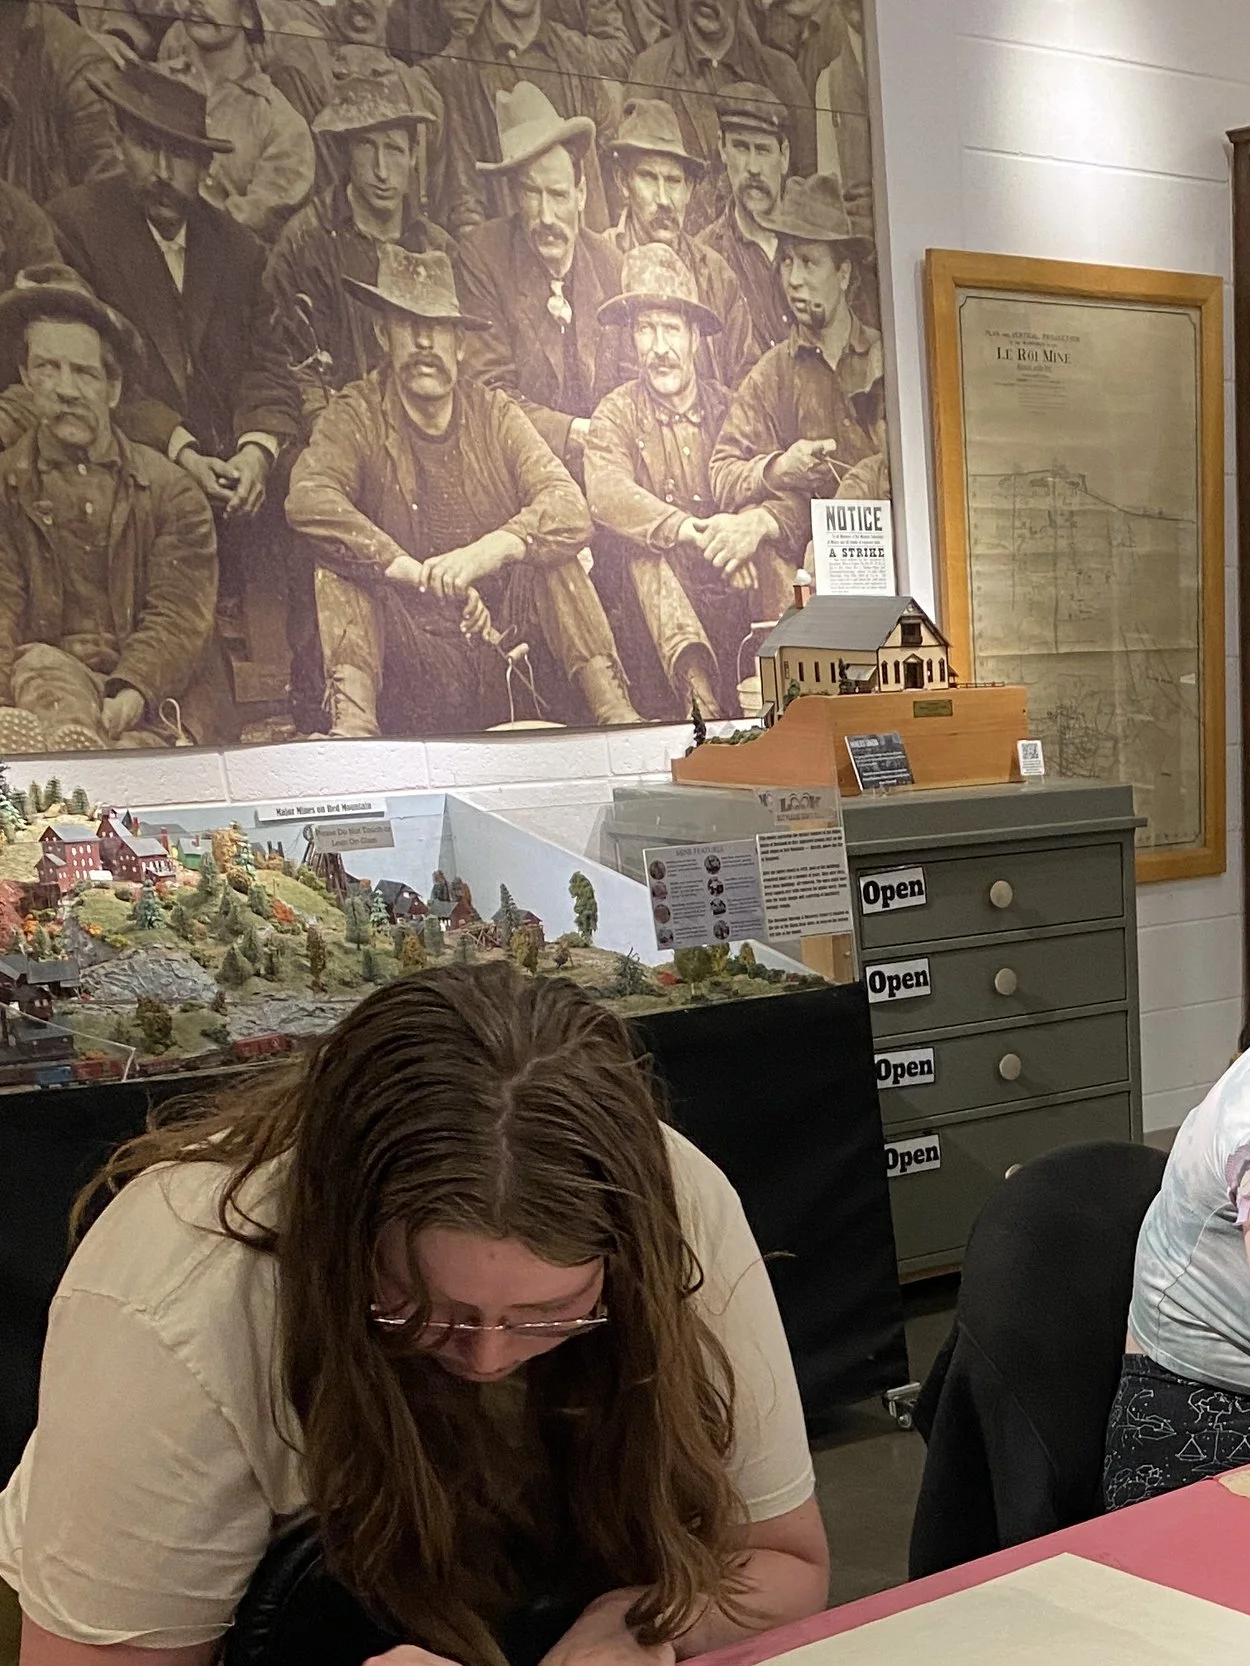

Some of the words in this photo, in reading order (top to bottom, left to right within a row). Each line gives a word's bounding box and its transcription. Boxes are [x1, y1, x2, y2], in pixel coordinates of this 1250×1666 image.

[996, 346, 1013, 361] LE
[1017, 347, 1039, 362] ROI
[1043, 349, 1072, 364] MINE
[826, 505, 883, 532] NOTICE
[829, 547, 837, 558] A
[842, 547, 885, 558] STRIKE
[275, 807, 295, 817] Major
[296, 806, 315, 815] Mines
[316, 805, 326, 814] on
[327, 803, 340, 813] Red
[341, 801, 372, 811] Mountain
[780, 793, 822, 812] LOOK
[338, 827, 347, 836] Do
[348, 826, 361, 835] Not
[362, 825, 384, 834] Touch
[331, 839, 348, 847] Lean
[862, 878, 924, 908] Open
[868, 969, 929, 998] Open
[876, 1058, 933, 1082] Open
[886, 1144, 940, 1173] Open
